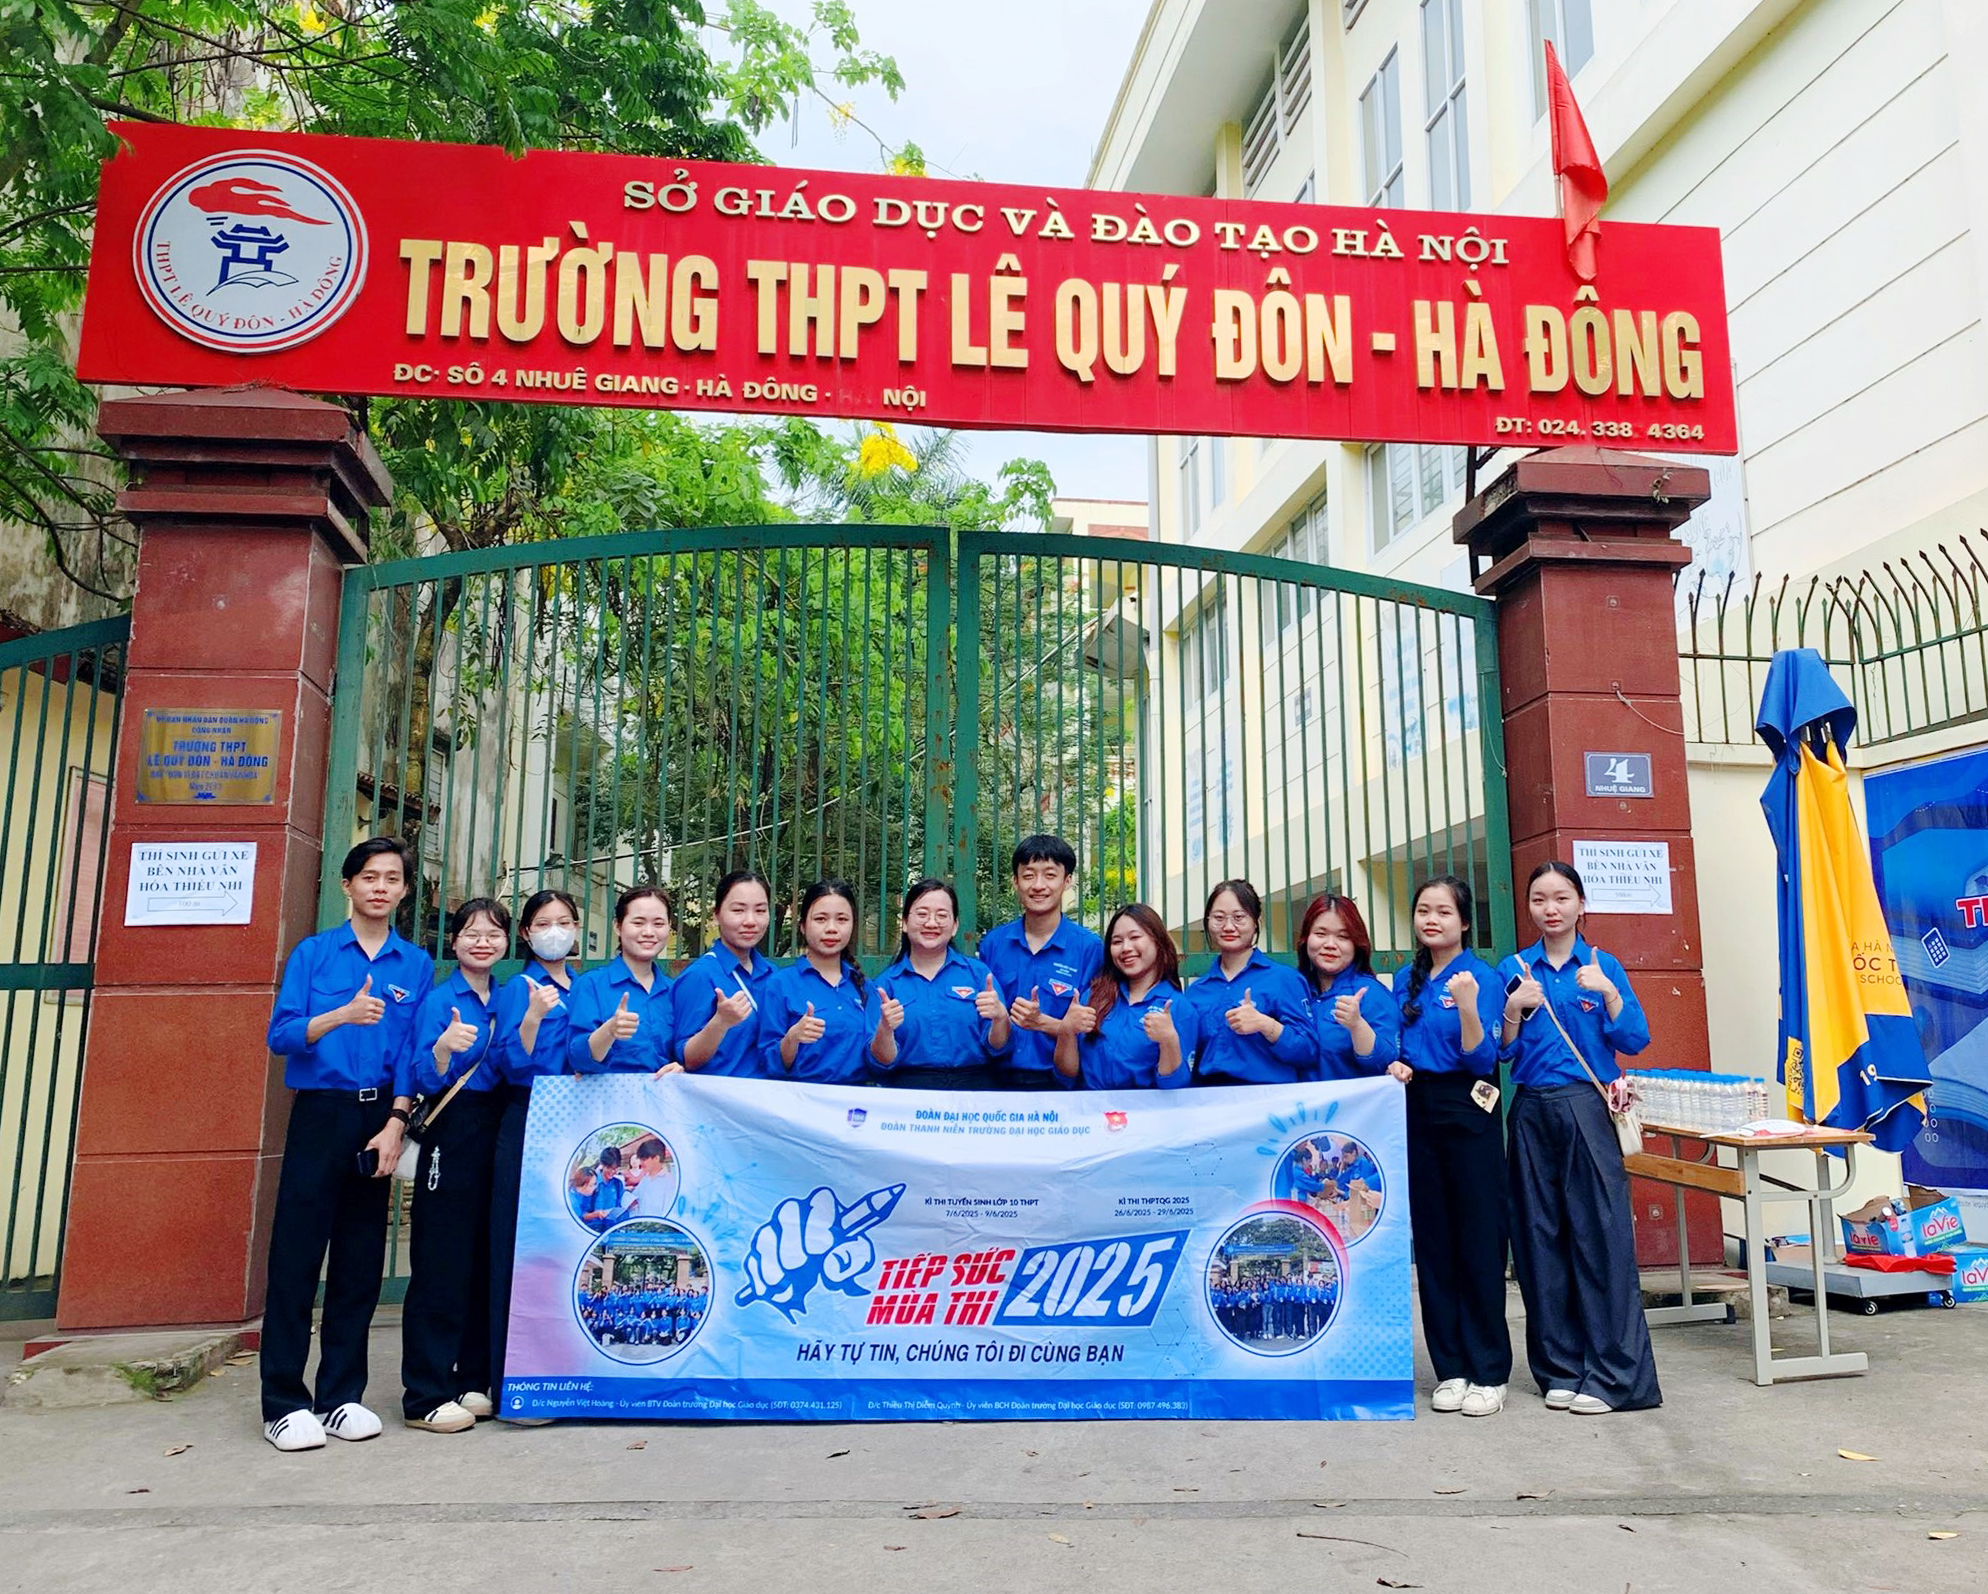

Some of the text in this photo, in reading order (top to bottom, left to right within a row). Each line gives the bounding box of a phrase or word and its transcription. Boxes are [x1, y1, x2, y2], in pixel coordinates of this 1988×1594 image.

[623, 168, 1510, 273] SỞ GIÁO DỤC VÀ ĐÀO TẠO HÀ NỘI
[156, 241, 342, 330] THPT LÊ QUÝ ĐÔN HÀ ĐÔNG
[399, 221, 1705, 400] TRƯỜNG THPT LÊ QUÝ ĐÔN - HÀ ĐÔNG
[491, 369, 508, 386] 4
[594, 373, 679, 395] GIANG
[697, 374, 732, 397] HÀ
[742, 377, 818, 402] ĐÔNG
[883, 385, 926, 411] NỘI
[1495, 417, 1532, 433] ĐT:
[1538, 419, 1586, 436] 024.
[220, 741, 246, 752] THPT
[1603, 758, 1635, 784] 4
[166, 851, 198, 860] SINH
[230, 850, 250, 860] XE
[1600, 849, 1624, 857] SINH
[1649, 849, 1663, 858] XE
[139, 879, 168, 891] HÓA
[218, 881, 242, 891] NHI
[1644, 876, 1663, 885] NHI
[1864, 940, 1882, 952] HÀ
[916, 1108, 941, 1120] ĐOÀN
[943, 1111, 959, 1123] ĐẠI
[961, 1112, 980, 1124] HỌC
[982, 1110, 1007, 1122] QUỐC
[1010, 1112, 1025, 1122] GIA
[1028, 1111, 1040, 1122] HÀ
[880, 1121, 1090, 1137] ĐOÀN THANH NIÊN TRƯỜNG ĐẠI HỌC GIÁO DỤC
[1141, 1197, 1171, 1205] THPTQG
[1172, 1196, 1190, 1204] 2025
[946, 1210, 1018, 1218] 7/6/2025 9/6/2025
[1114, 1207, 1194, 1217] 26/6/2025 29/6/2025
[877, 1247, 1016, 1290] TIẾP SỨC
[1003, 1237, 1175, 1318] 2025
[865, 1290, 999, 1325] MÙA THI
[796, 1340, 1124, 1366] HÃY TỰ TIN, CHÚNG TÔI ĐI CÙNG BẠN
[542, 1382, 556, 1391] TIN
[559, 1381, 579, 1391] LIÊN
[994, 1401, 1010, 1409] BCH
[1071, 1401, 1084, 1410] học
